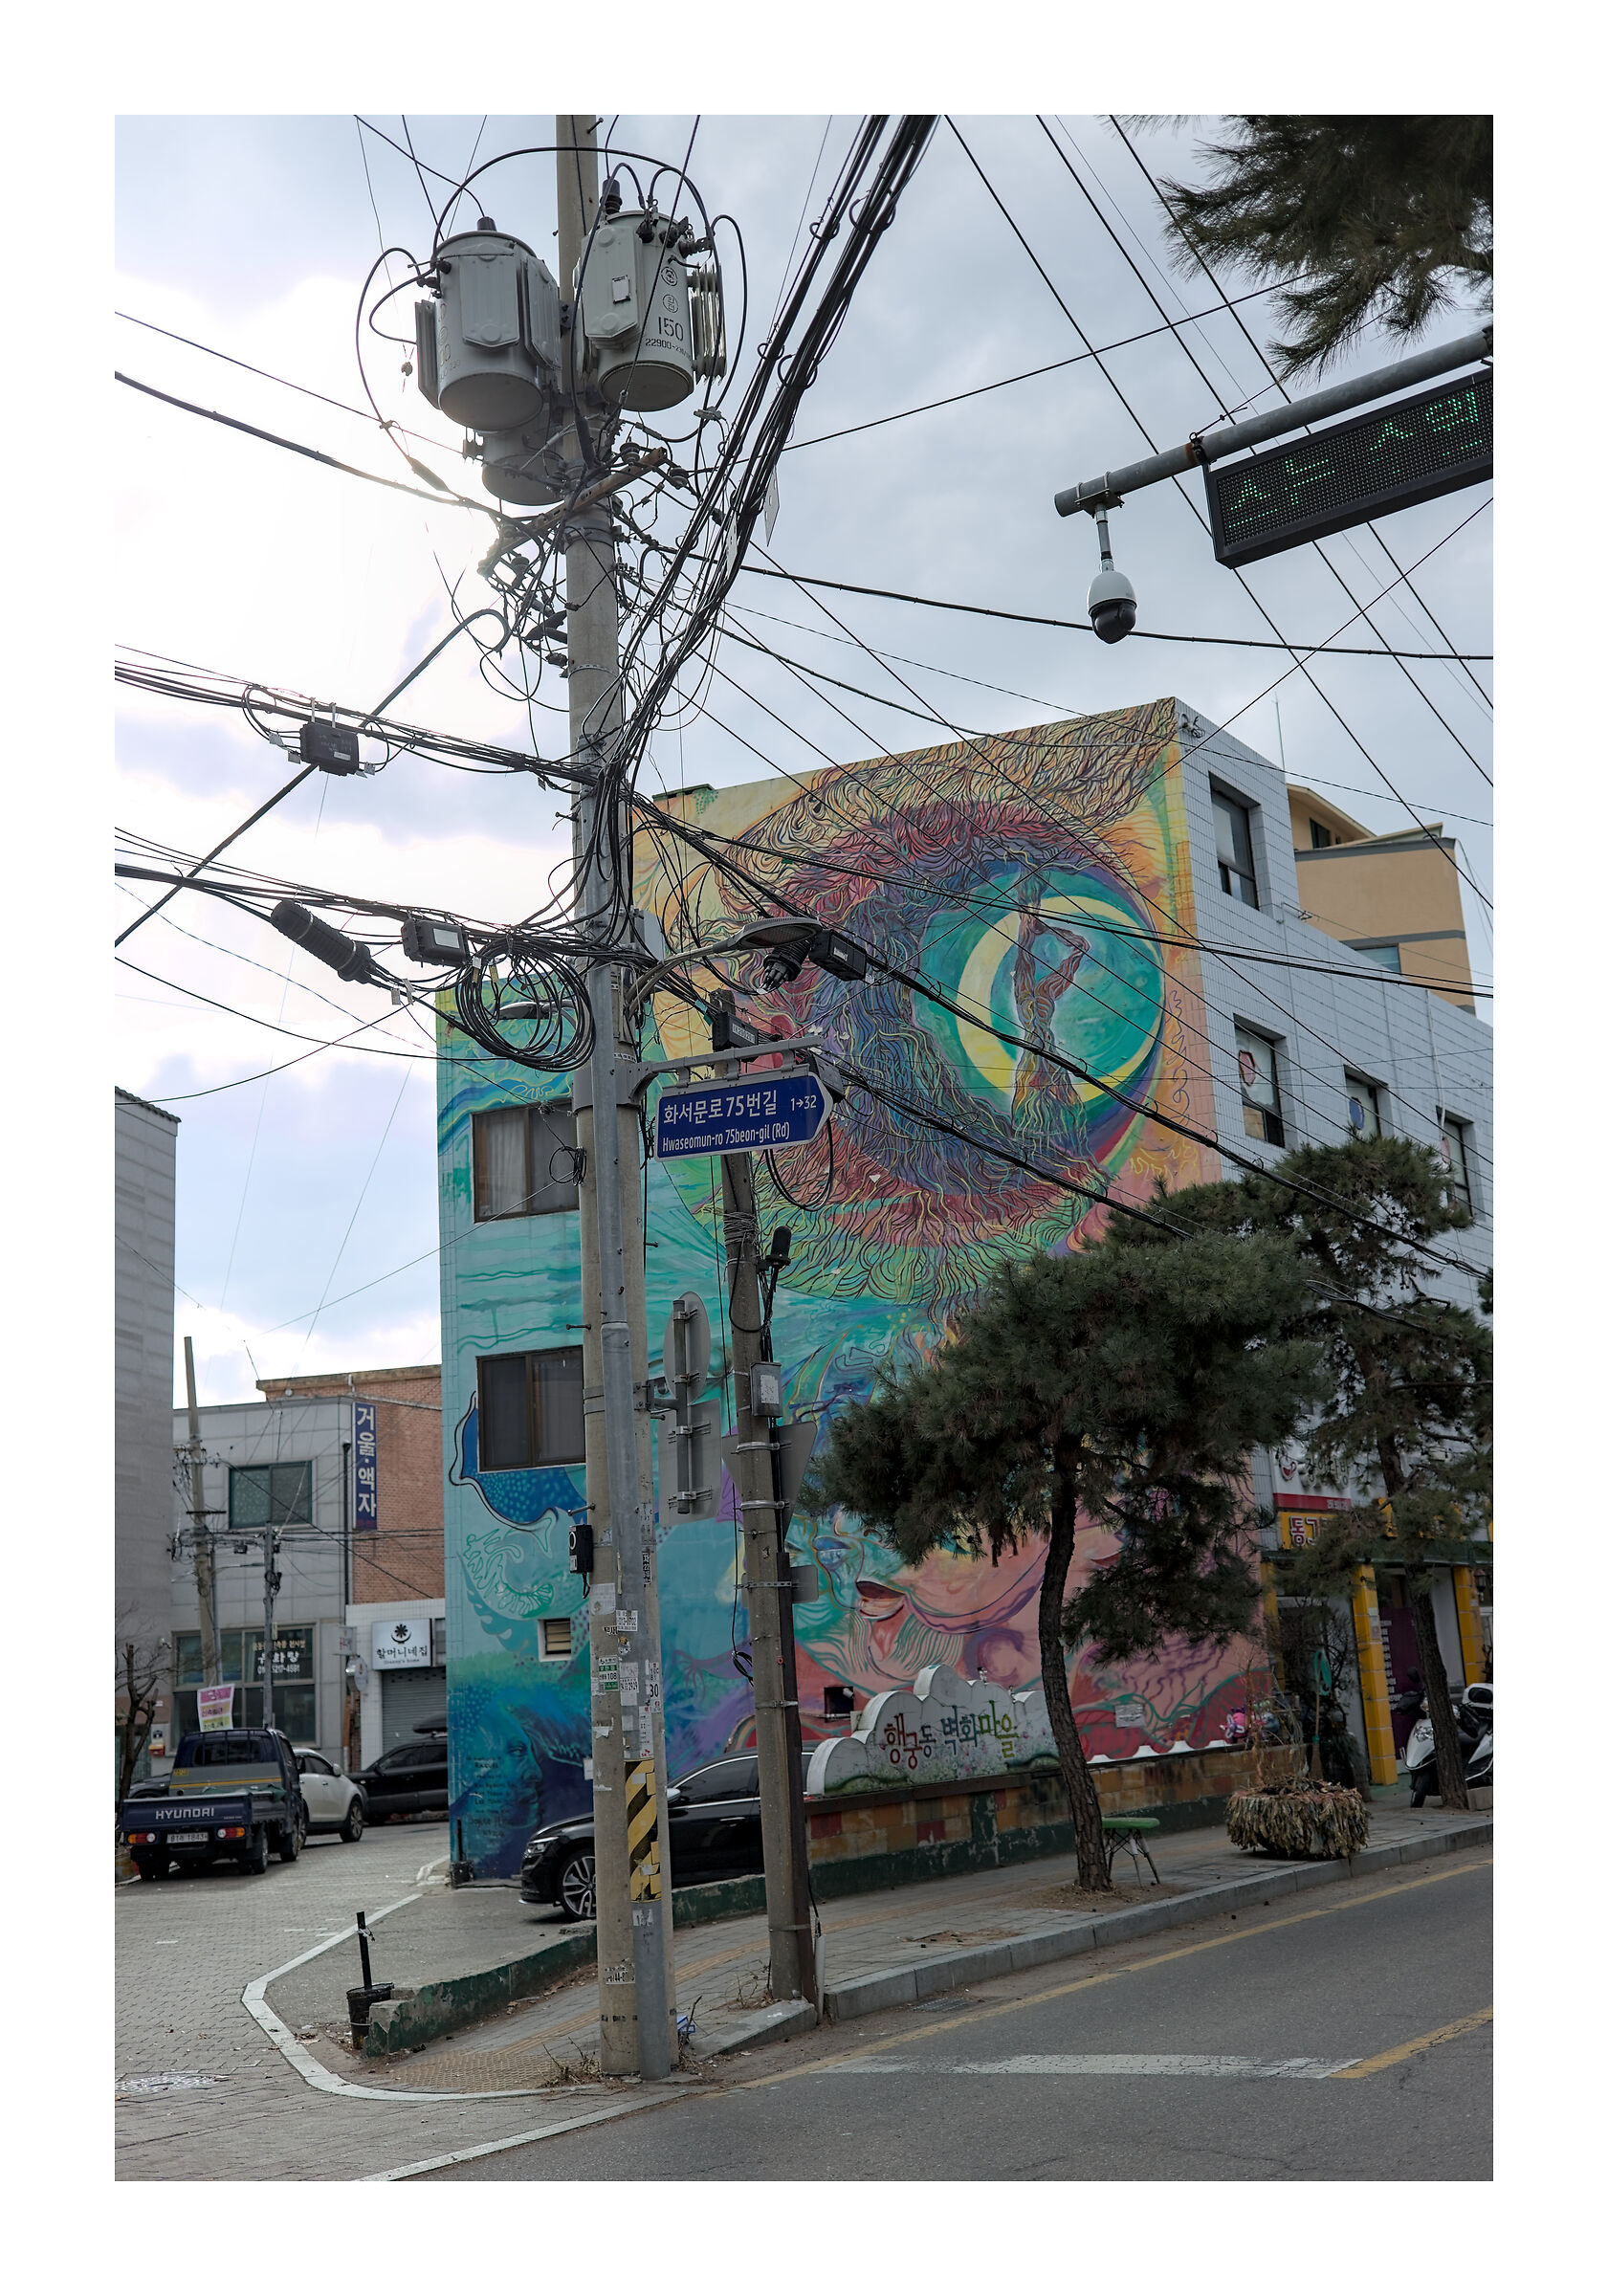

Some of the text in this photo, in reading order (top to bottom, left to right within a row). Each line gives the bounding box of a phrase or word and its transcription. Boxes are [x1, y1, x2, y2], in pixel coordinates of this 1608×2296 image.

[658, 316, 684, 342] 150
[662, 1121, 790, 1152] Hwaseomun-ro 75beon-gil (Rd)
[884, 1712, 936, 1770] 행궁동
[155, 1807, 215, 1821] HYUNDAI
